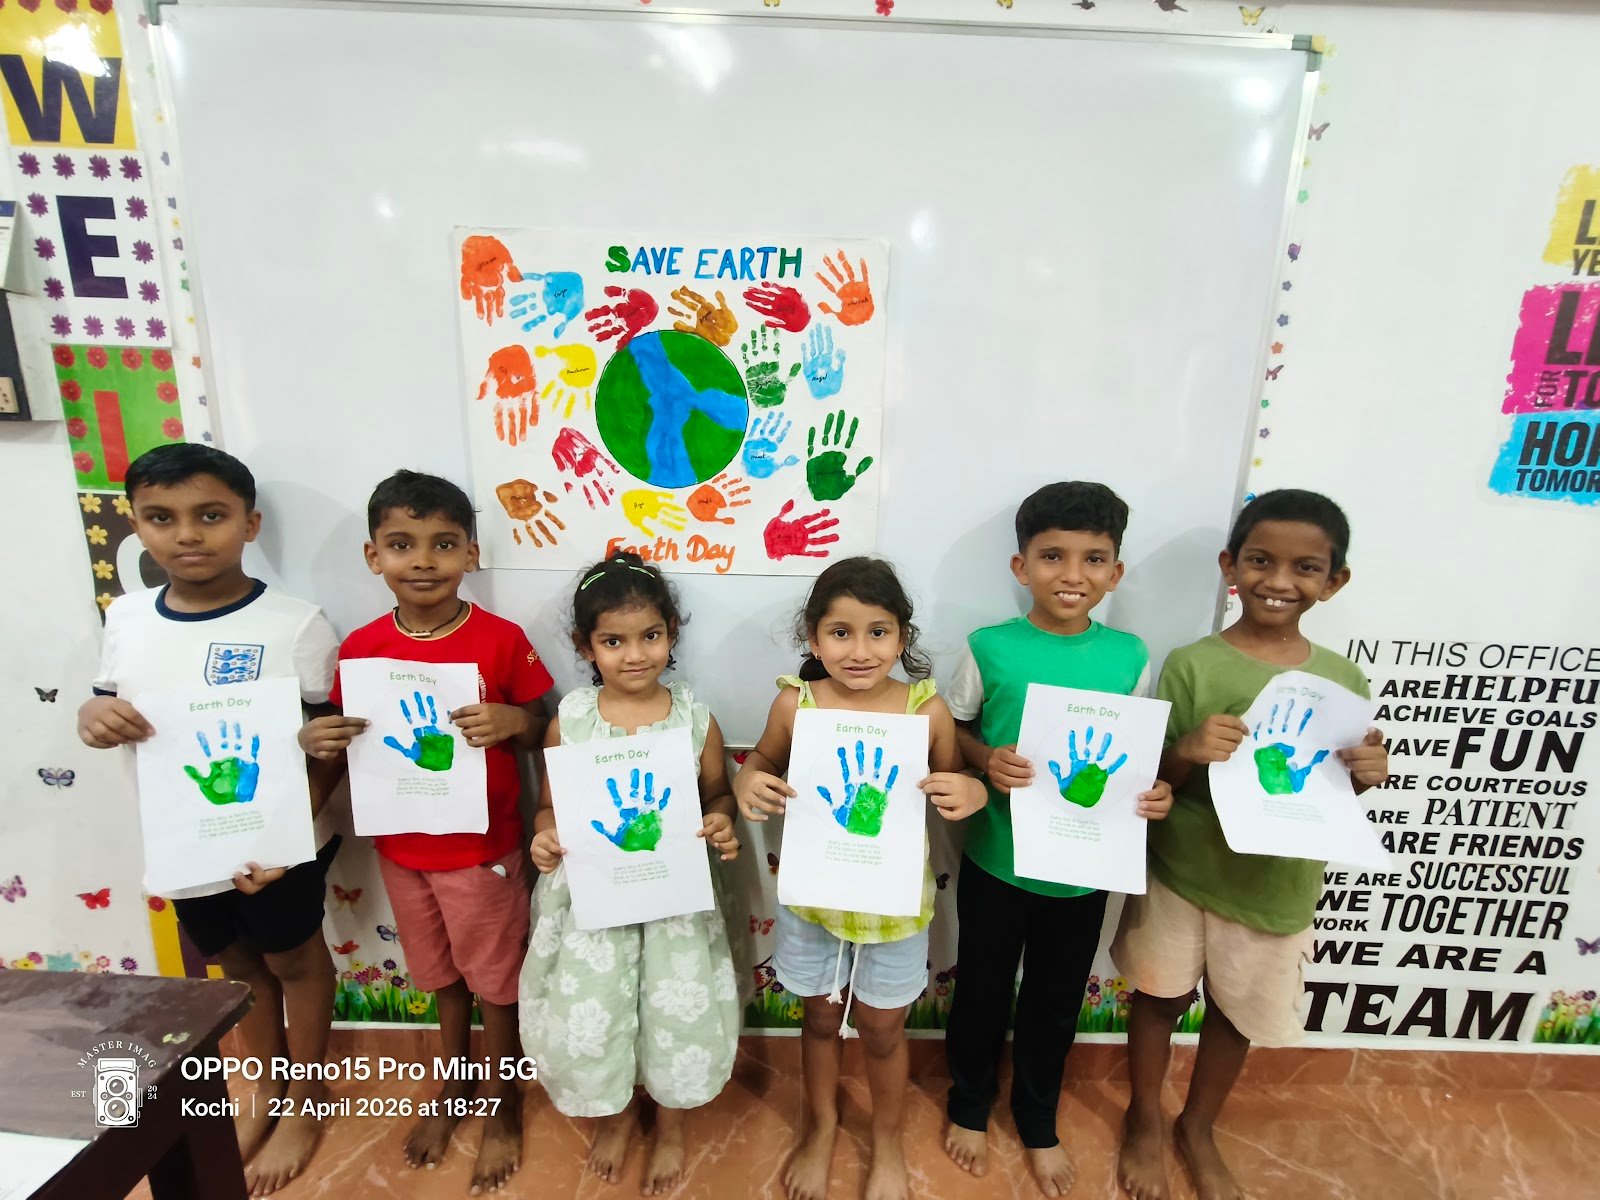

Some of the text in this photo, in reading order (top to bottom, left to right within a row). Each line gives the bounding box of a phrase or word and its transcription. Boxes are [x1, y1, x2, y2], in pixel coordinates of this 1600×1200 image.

[605, 245, 802, 281] SAVE EARTH
[687, 534, 736, 574] Day
[1347, 639, 1600, 672] IN THIS OFFICE
[389, 672, 437, 686] Earth Day
[1379, 679, 1441, 698] ARE
[189, 697, 252, 712] Earth Day
[1067, 703, 1121, 720] Earth Day
[1373, 704, 1598, 728] ACHIEVE GOALS
[836, 723, 887, 737] Earth Day
[595, 749, 650, 764] Earth Day
[1450, 727, 1585, 773] FUN
[1426, 775, 1588, 796] COURTEOUS
[1366, 798, 1578, 830] ARE PATIENT
[1381, 830, 1585, 860] ARE FRIENDS
[1354, 872, 1402, 887] ARE
[1406, 861, 1570, 895] SUCCESSFUL
[1380, 892, 1569, 940] TOGETHER
[1312, 940, 1547, 975] WE ARE A
[1303, 981, 1536, 1042] TEAM
